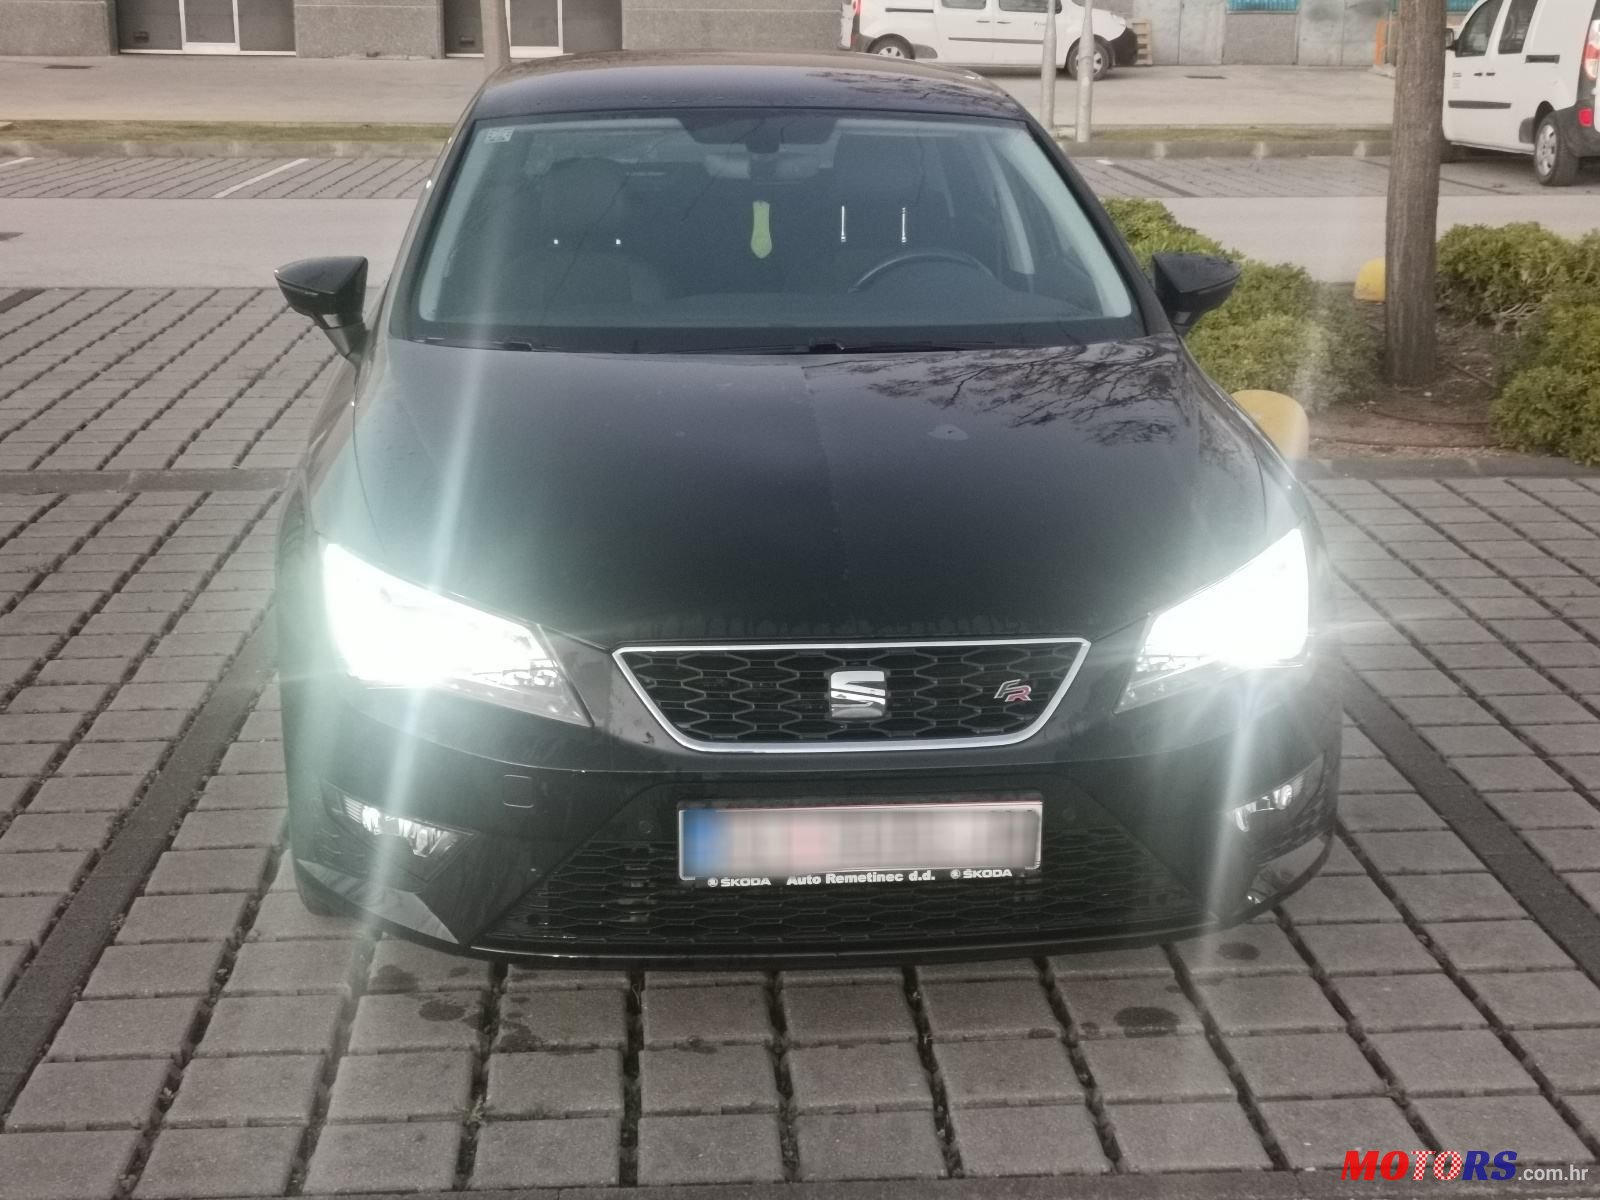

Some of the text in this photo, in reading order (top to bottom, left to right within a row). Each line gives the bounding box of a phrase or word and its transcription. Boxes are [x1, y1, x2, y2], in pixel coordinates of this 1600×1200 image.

[994, 678, 1032, 703] FR
[786, 874, 822, 886] Auto
[825, 872, 904, 884] Remetinec
[908, 869, 936, 882] d.d.
